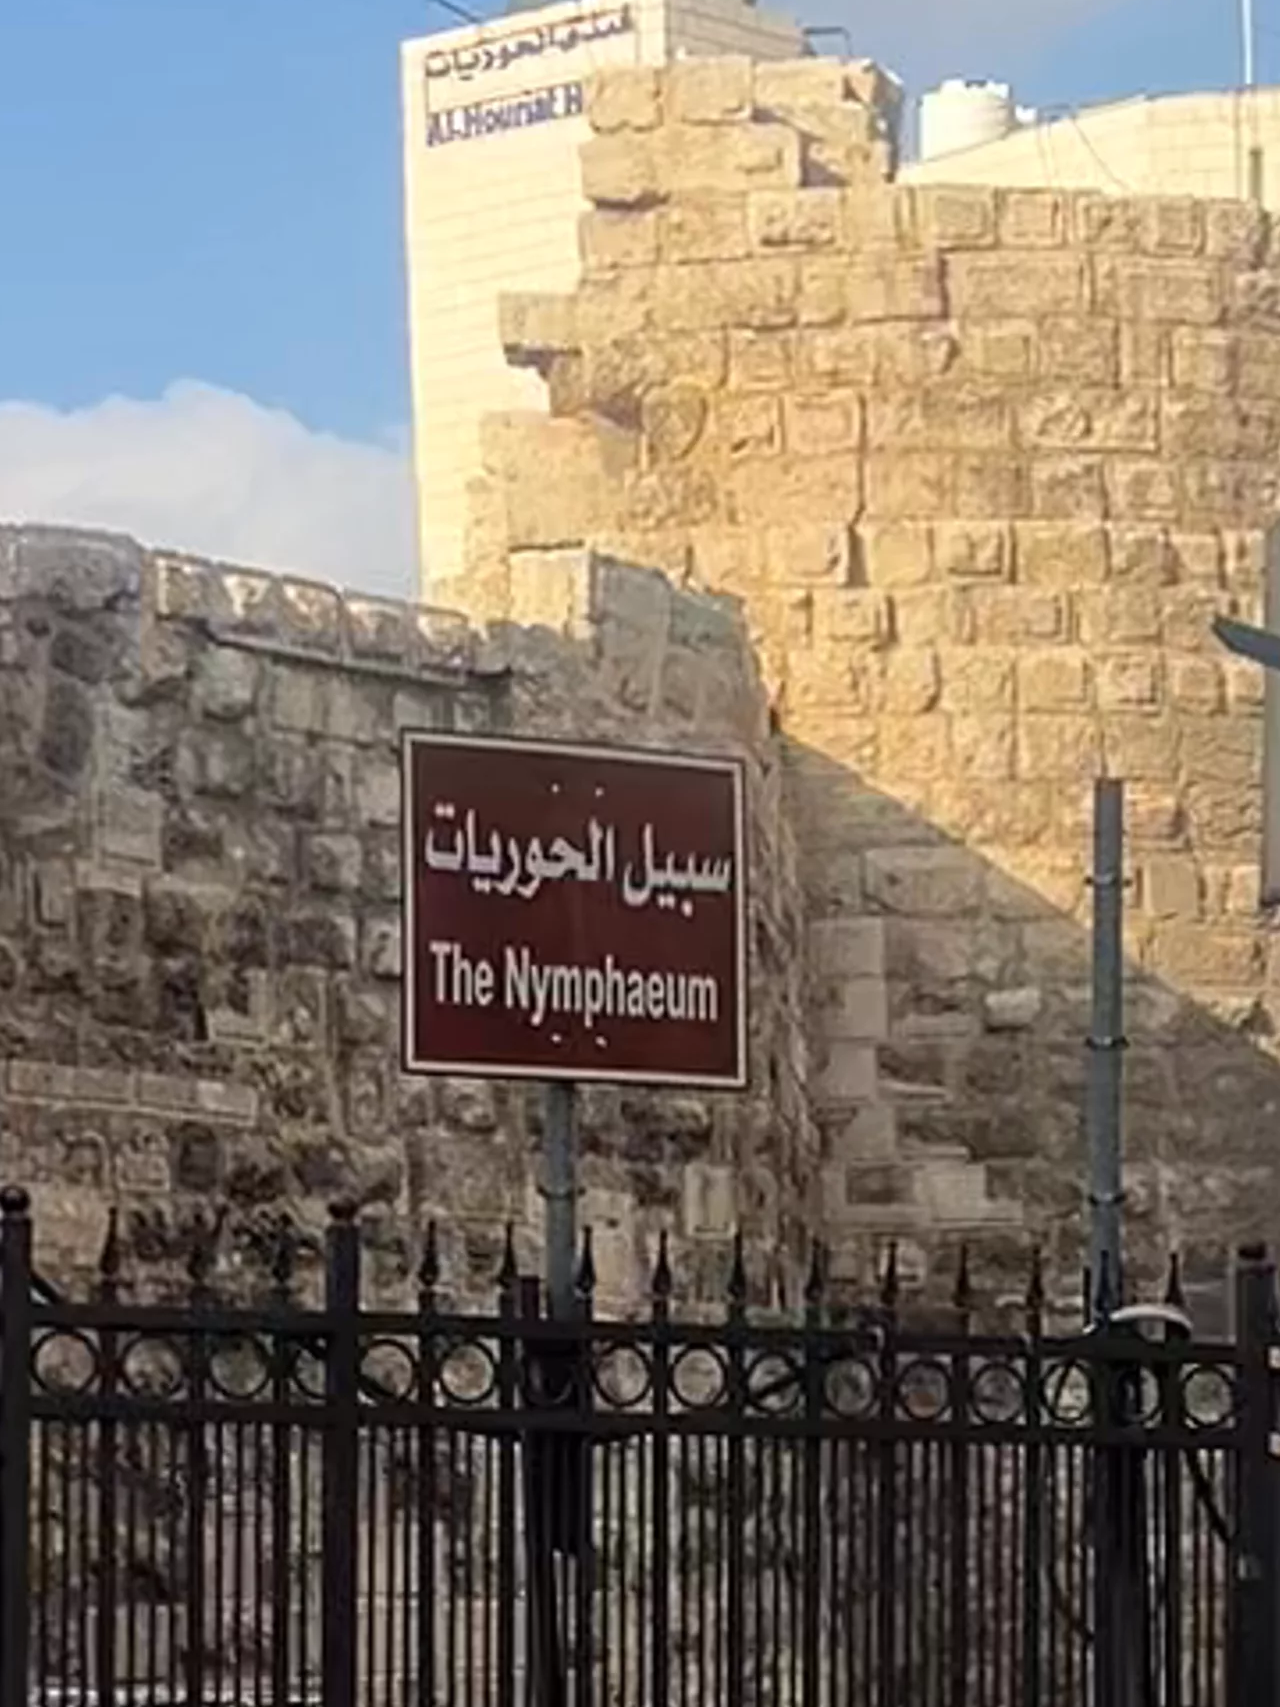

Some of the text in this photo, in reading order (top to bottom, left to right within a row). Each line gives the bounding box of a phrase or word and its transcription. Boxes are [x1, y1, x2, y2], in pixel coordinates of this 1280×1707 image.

[424, 800, 733, 918] سبيل الحوريات
[428, 939, 719, 1029] The Nymphaeum
